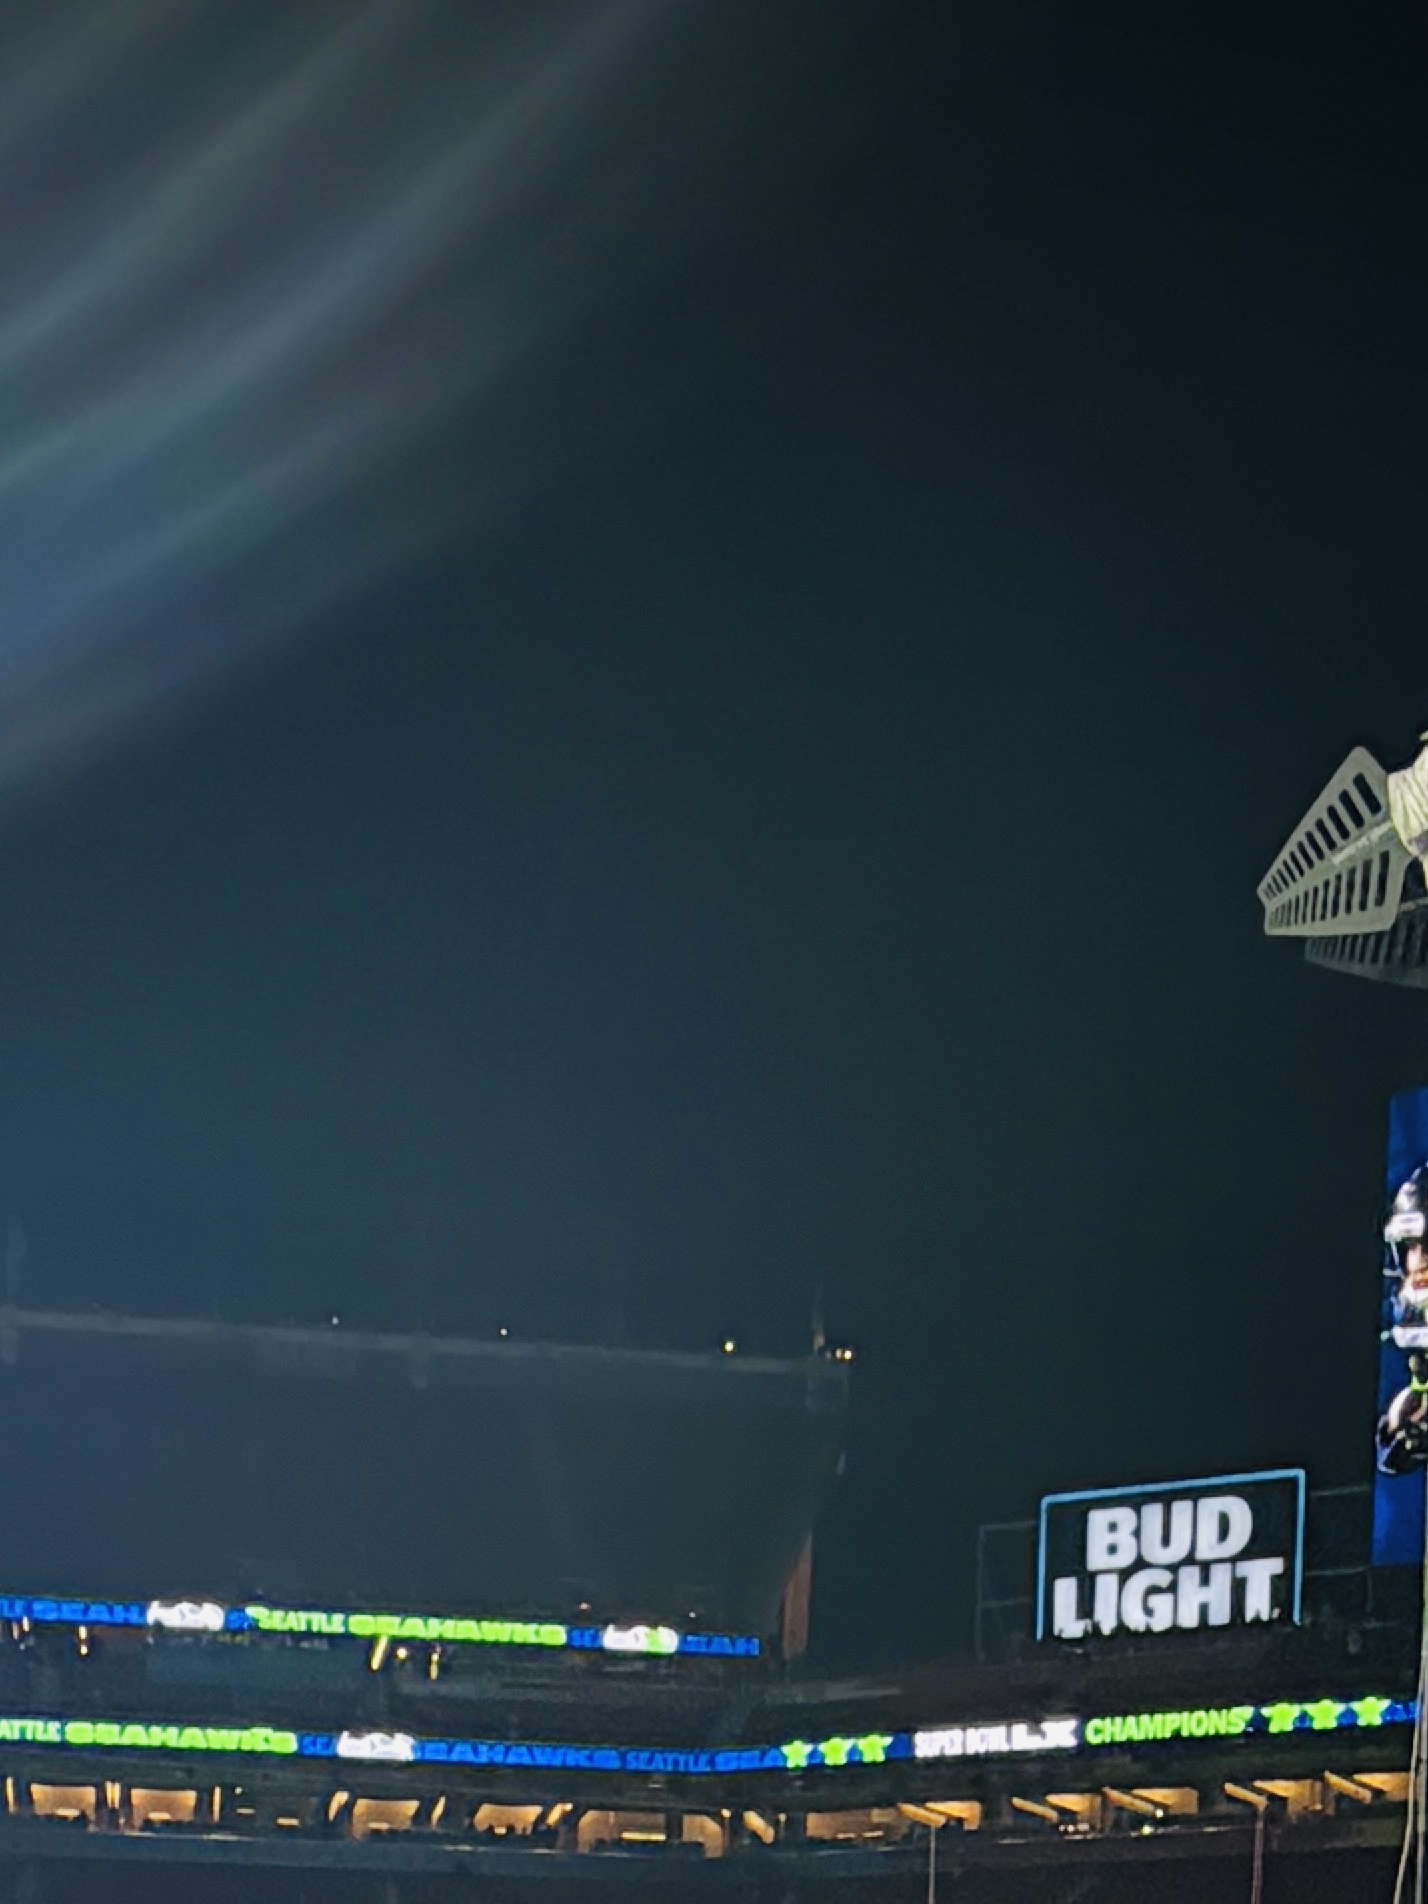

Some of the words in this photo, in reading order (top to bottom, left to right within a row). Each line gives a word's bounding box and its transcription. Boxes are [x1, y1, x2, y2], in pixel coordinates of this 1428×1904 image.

[1085, 1495, 1253, 1574] BUD
[1053, 1556, 1285, 1641] LIGHT
[347, 1614, 567, 1647] SEAHAWKS
[63, 1721, 299, 1755] SEAHAWKS
[1013, 1719, 1079, 1750] LX
[1084, 1706, 1252, 1746] CHAMPIONS
